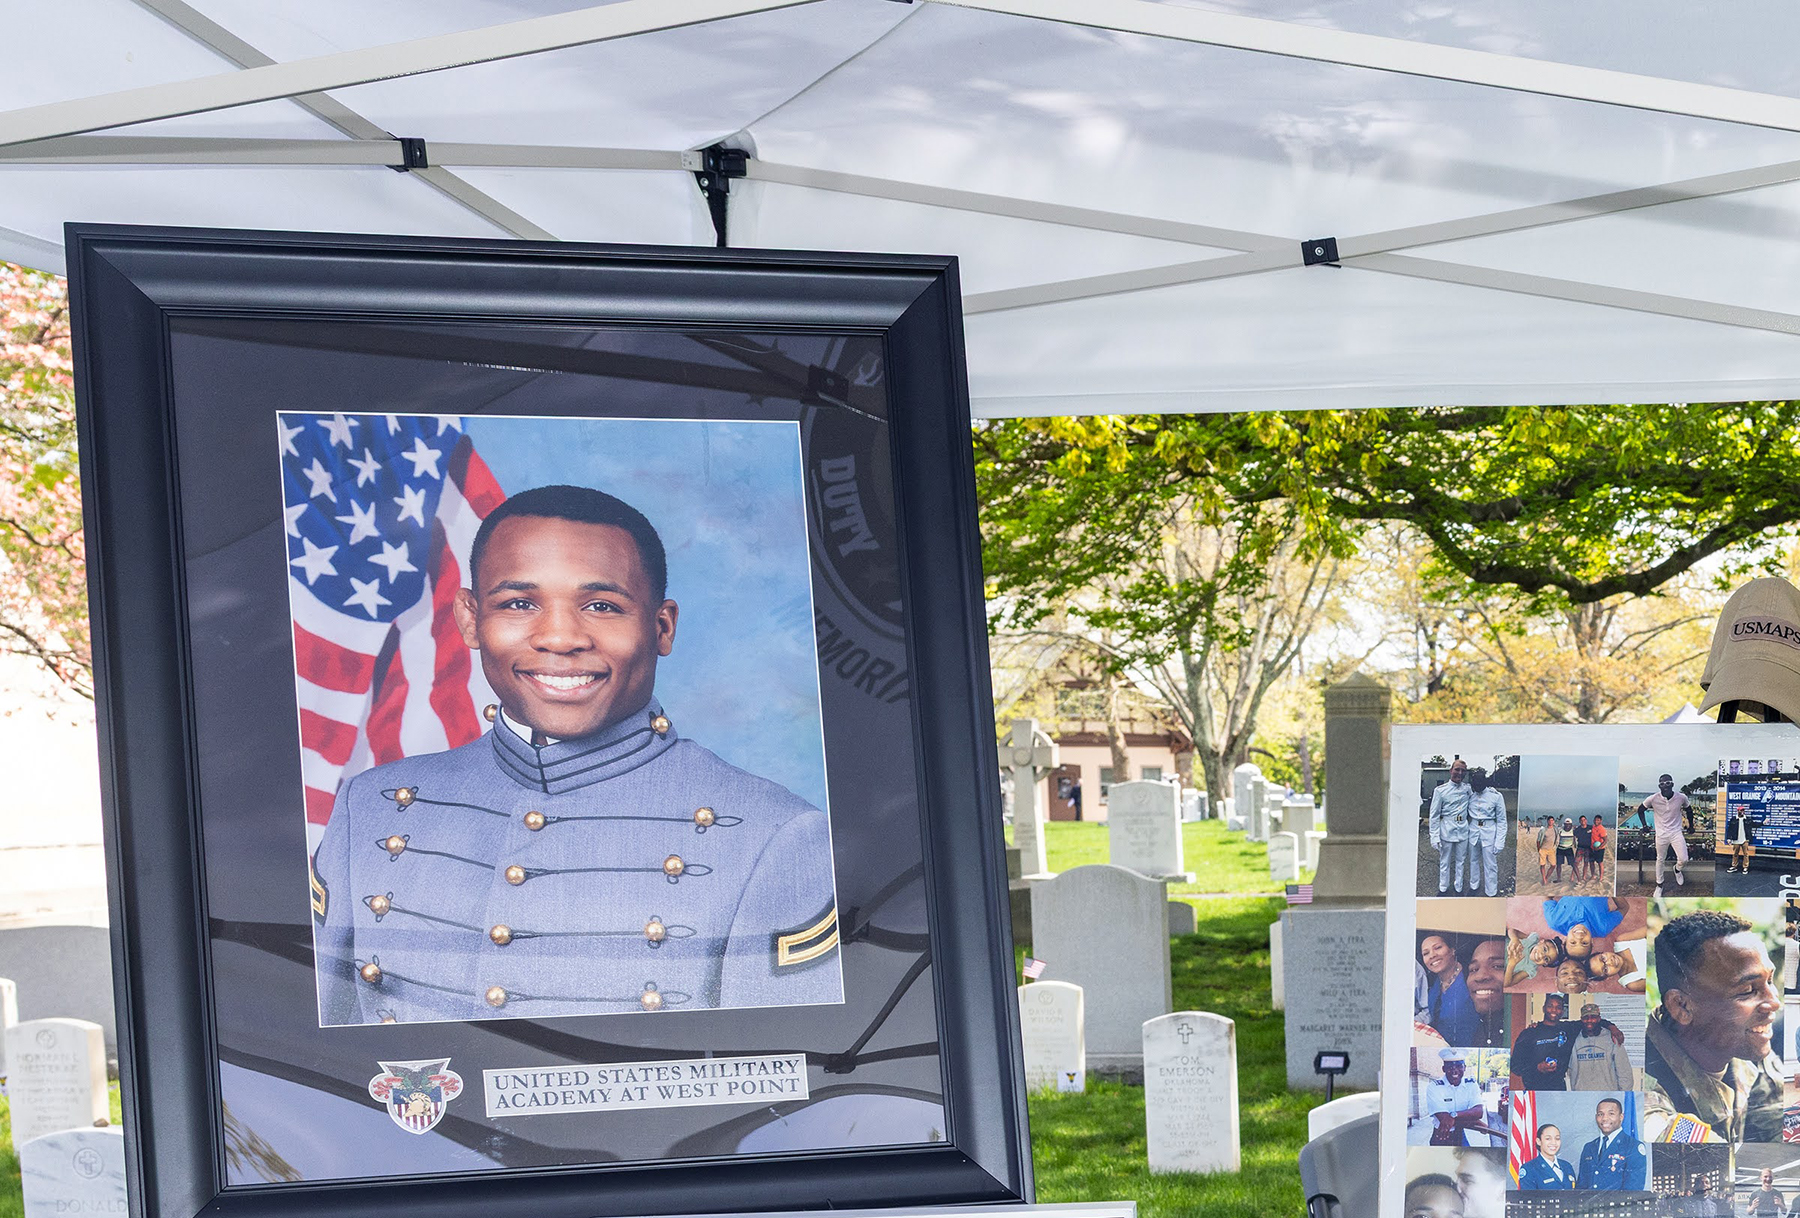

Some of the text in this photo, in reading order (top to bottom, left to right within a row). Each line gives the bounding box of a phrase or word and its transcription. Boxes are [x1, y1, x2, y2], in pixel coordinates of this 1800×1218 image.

[820, 454, 881, 559] DUTY
[1173, 1056, 1201, 1065] TOM
[493, 1059, 800, 1090] UNITED STATES MILITARY
[1159, 1067, 1215, 1077] EMERSON
[495, 1078, 800, 1109] ACADEMY AT WEST POINT
[55, 1199, 128, 1213] DONALD
